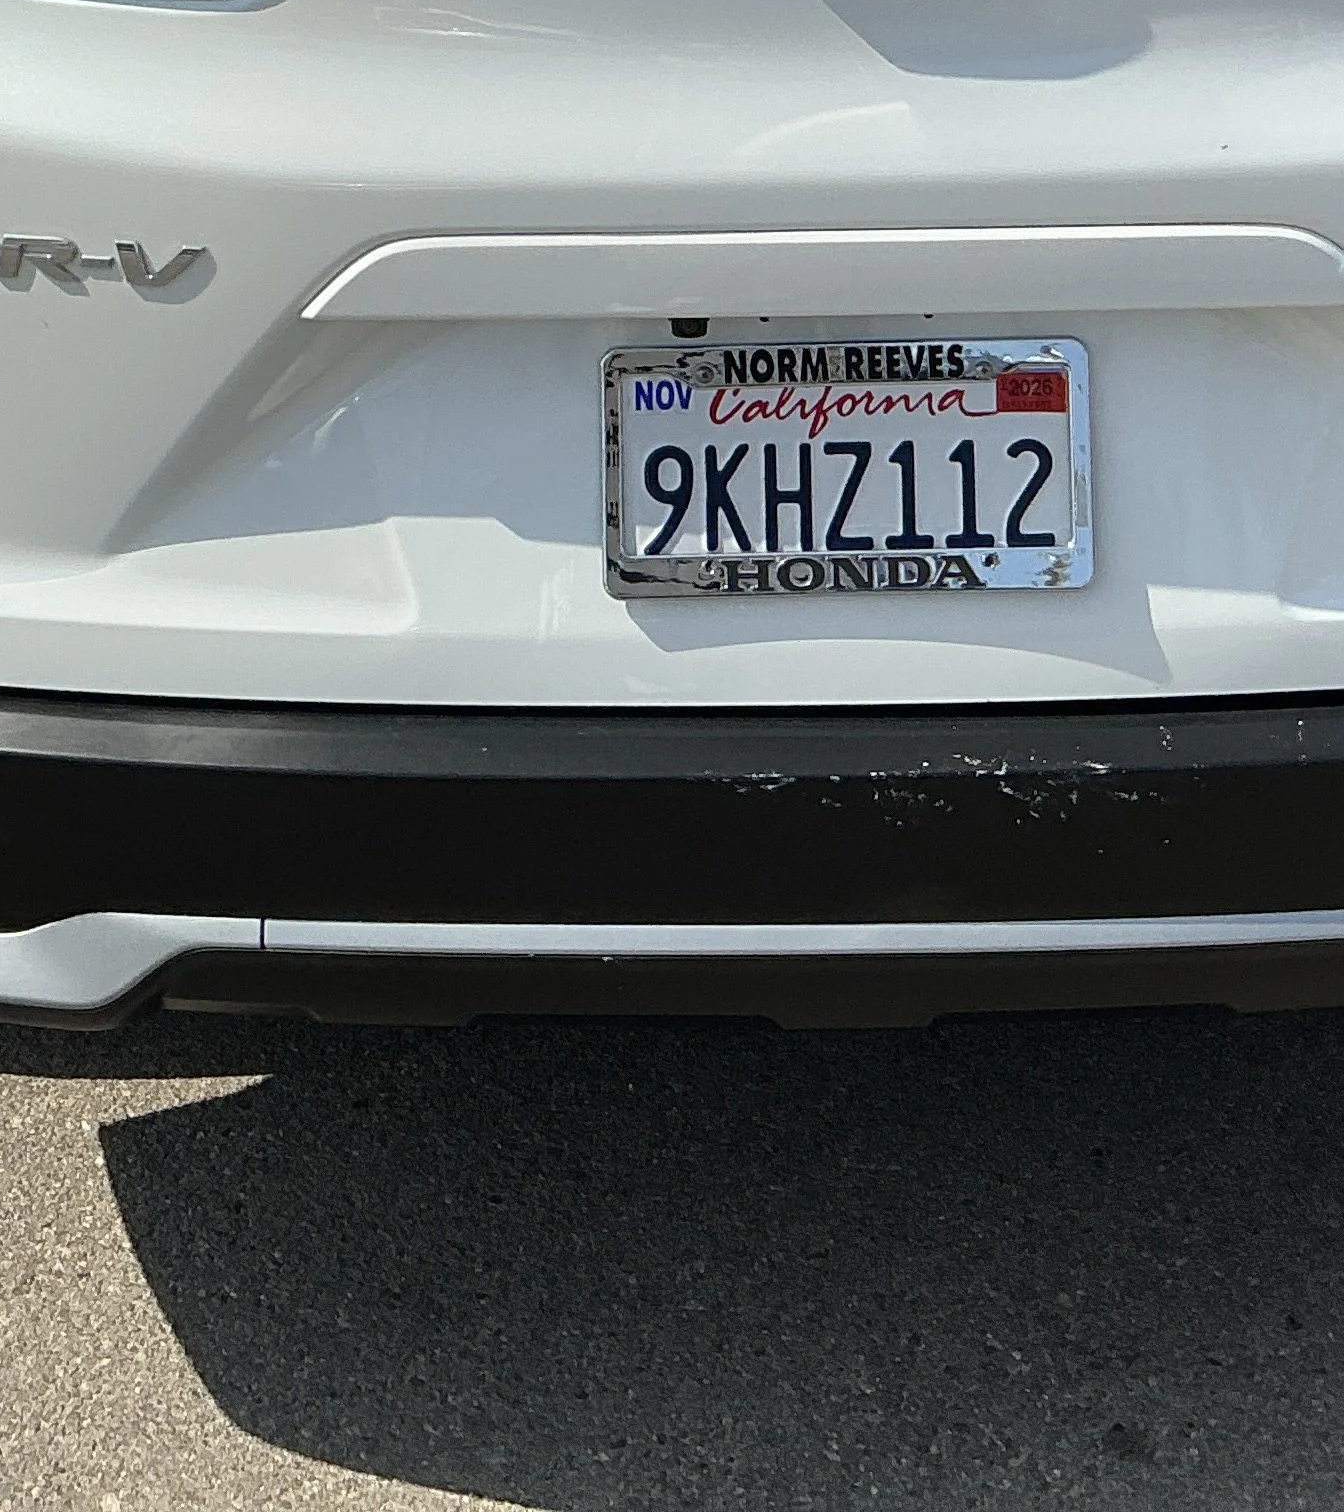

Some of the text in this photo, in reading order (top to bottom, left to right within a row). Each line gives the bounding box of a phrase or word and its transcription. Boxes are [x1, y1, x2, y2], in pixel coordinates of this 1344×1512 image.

[723, 344, 965, 385] NORM REEVES
[635, 380, 692, 412] NOV
[1008, 378, 1053, 397] 2026
[709, 386, 994, 439] California
[643, 438, 1055, 556] 9KHZ112
[722, 553, 986, 592] HONDA
